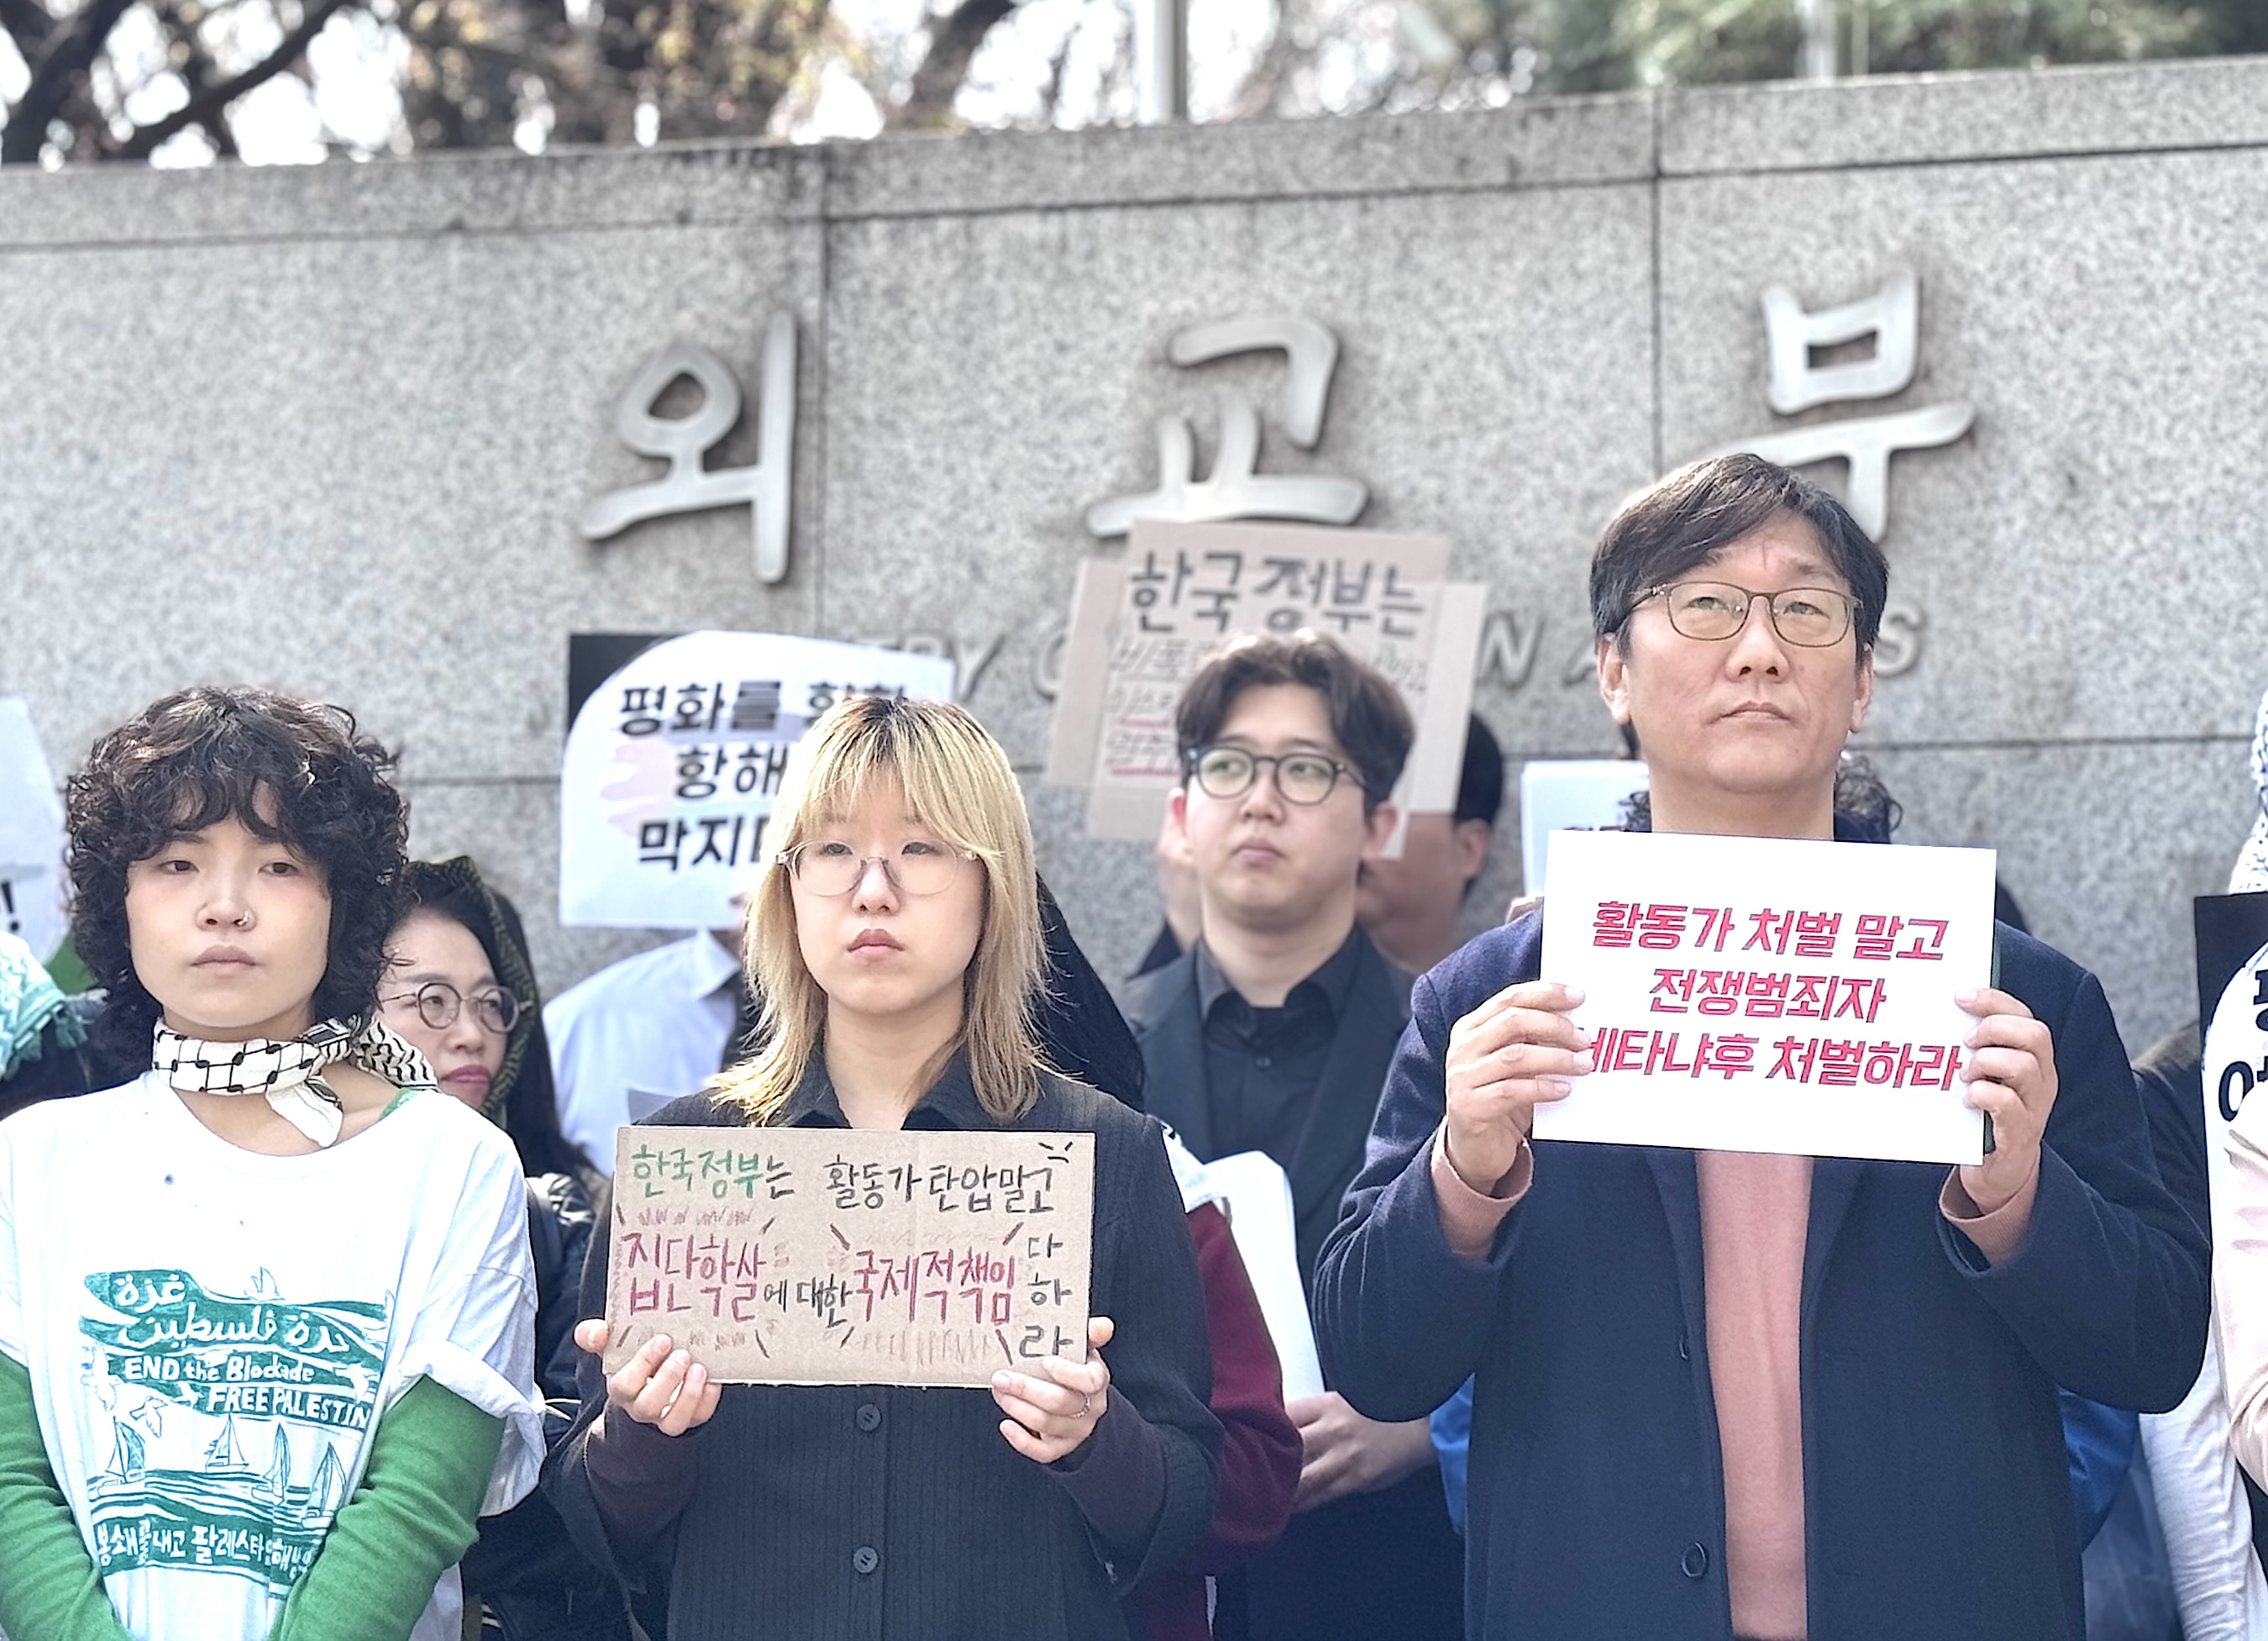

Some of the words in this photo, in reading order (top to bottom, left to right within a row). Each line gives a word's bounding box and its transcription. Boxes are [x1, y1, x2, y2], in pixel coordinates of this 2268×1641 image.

[1129, 549, 1425, 638] 한국정부는
[1593, 901, 1735, 952] 활동가
[1741, 907, 1842, 958] 처벌
[1853, 914, 1950, 960] 말고
[1650, 968, 1887, 1023] 전쟁범죄자
[1765, 1036, 1962, 1091] 처벌하라
[632, 1144, 795, 1199] 한국정부는
[113, 1273, 186, 1313] غزة
[797, 1274, 853, 1328] 대한
[126, 1355, 180, 1381] END
[183, 1360, 220, 1381] the
[226, 1354, 315, 1382] Blockade
[207, 1386, 268, 1412] FREE
